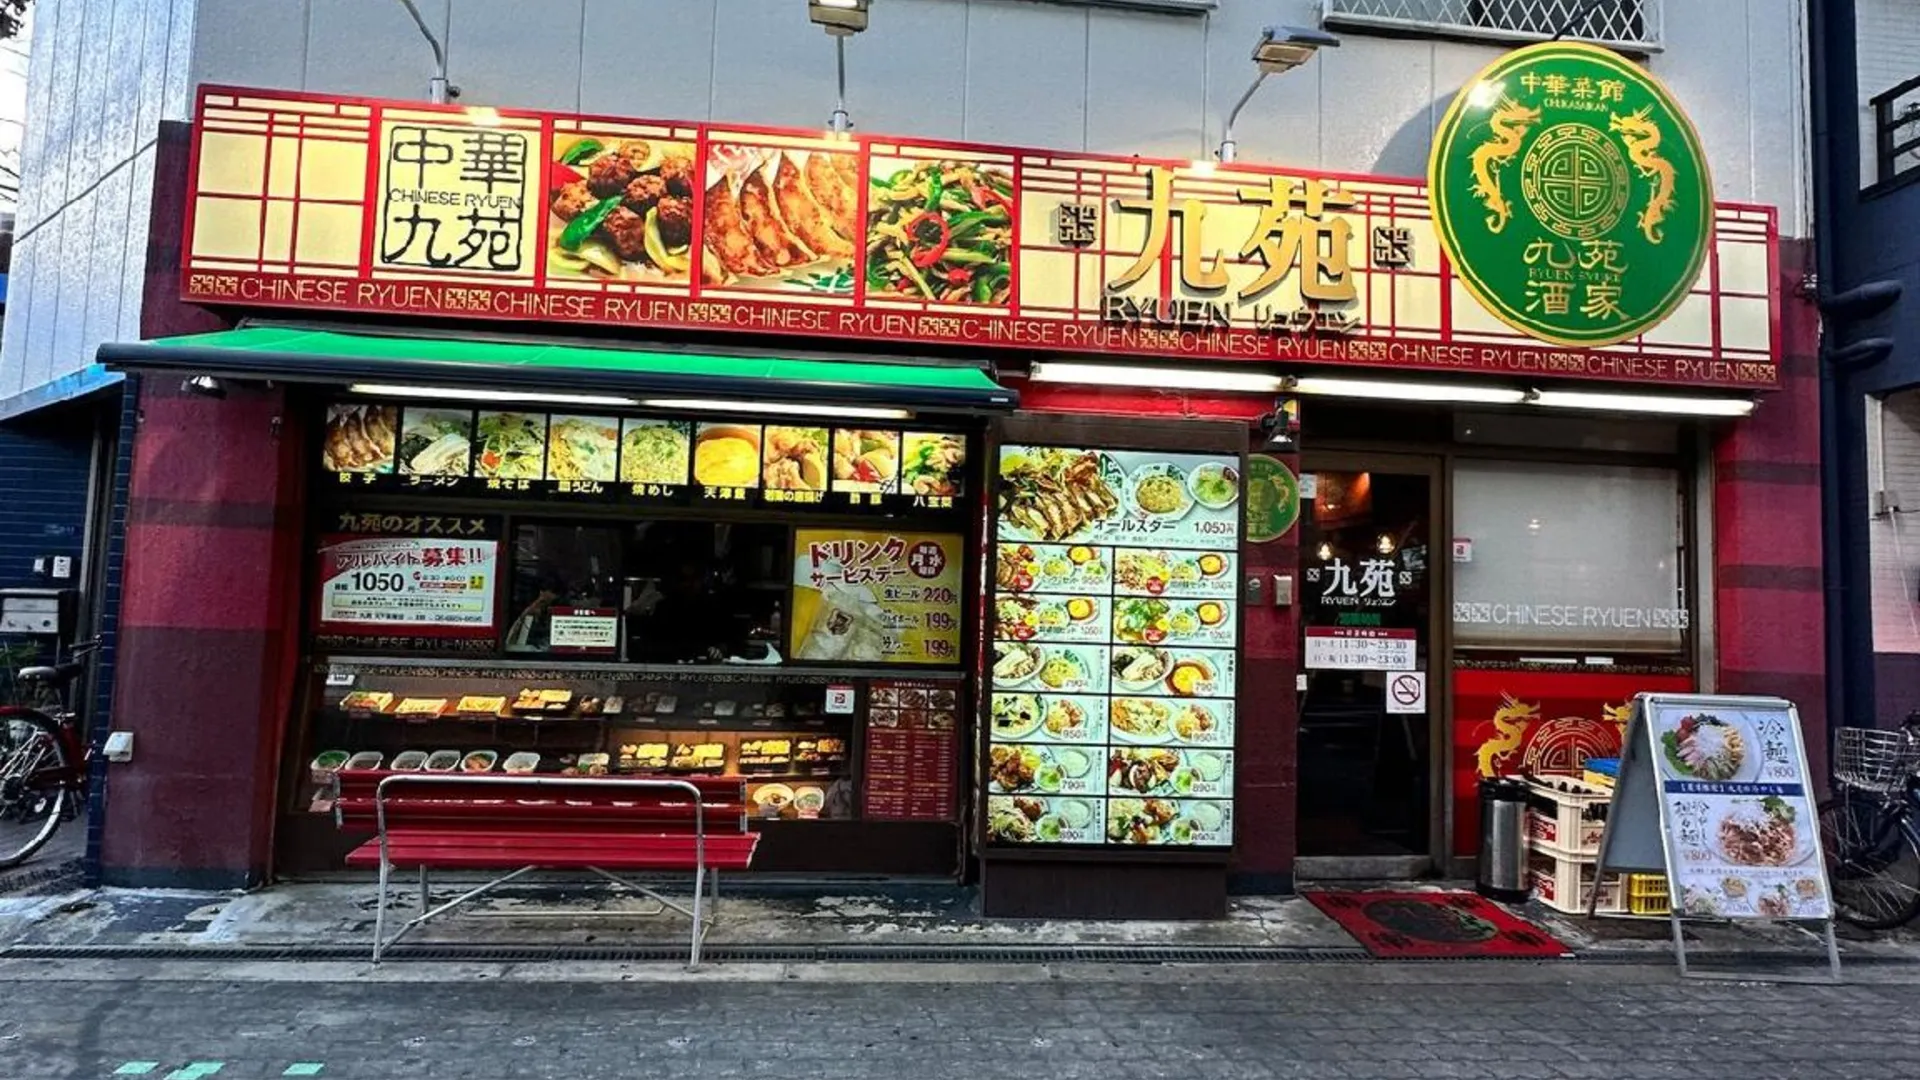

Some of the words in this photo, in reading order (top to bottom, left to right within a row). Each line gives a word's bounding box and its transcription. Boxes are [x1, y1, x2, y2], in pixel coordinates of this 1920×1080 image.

[1520, 71, 1626, 102] 中華菜館
[392, 128, 522, 193] 中華
[389, 188, 460, 206] CHINESE
[464, 193, 522, 210] RYUEN
[383, 203, 522, 270] 九苑
[1107, 167, 1360, 303] 九苑
[1523, 236, 1629, 274] 九苑
[1528, 267, 1575, 281] RYUEN
[1102, 296, 1232, 327] RYUEN
[1525, 281, 1631, 320] 酒家
[241, 278, 348, 304] CHINESE
[357, 283, 444, 310] RYUEN
[494, 292, 595, 319] CHINESE
[605, 299, 685, 322] RYUEN
[733, 306, 831, 330] CHINESE
[840, 312, 915, 336] RYUEN
[961, 319, 1056, 344] CHINESE
[1063, 326, 1137, 348] RYUEN
[1180, 331, 1270, 356] CHINESE
[1278, 337, 1347, 361] RYUEN
[1389, 343, 1473, 365] CHINESE
[1481, 348, 1550, 370] RYUEN
[1587, 356, 1668, 379] CHINESE
[1675, 361, 1740, 382] RYUEN
[409, 474, 459, 487] ラーメン
[487, 479, 530, 490] 焼そば
[338, 512, 487, 534] 九苑のオススメ
[1094, 518, 1176, 533] オールスター
[810, 536, 906, 568] ドリンク
[351, 572, 404, 592] 1050
[810, 566, 906, 587] サービスデー
[1322, 557, 1396, 598] 九苑
[884, 589, 919, 599] 生ビール
[1492, 603, 1578, 626] CHINESE
[1584, 607, 1650, 629] RYUEN
